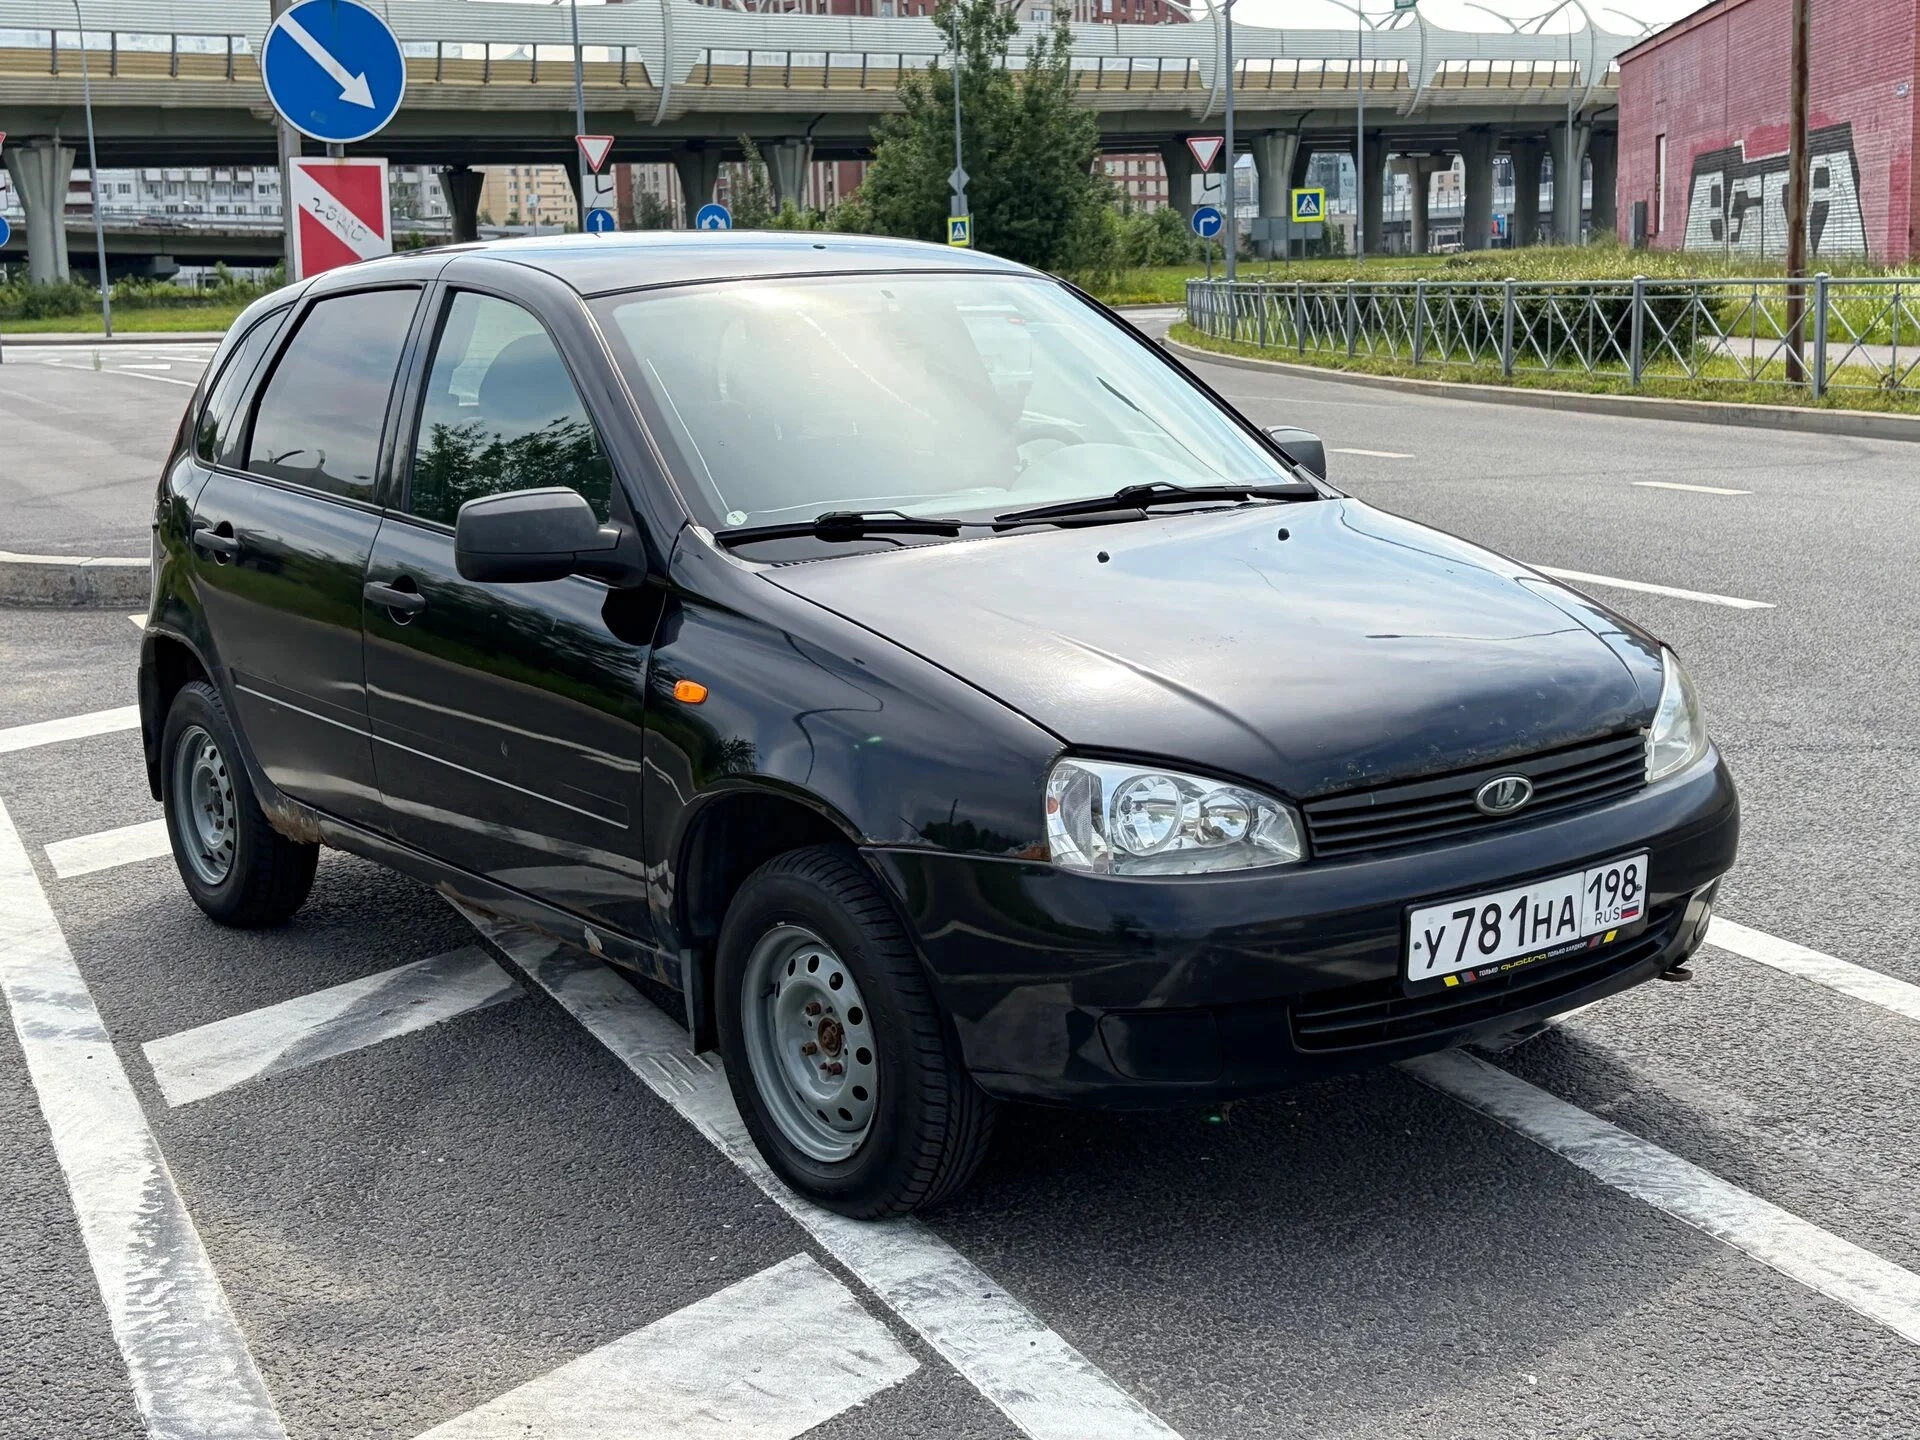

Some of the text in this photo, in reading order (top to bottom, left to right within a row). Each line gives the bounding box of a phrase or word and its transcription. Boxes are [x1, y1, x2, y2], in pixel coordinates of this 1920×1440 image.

[1588, 864, 1637, 911] 198
[1424, 895, 1576, 970] У781НА
[1595, 906, 1620, 926] RUS
